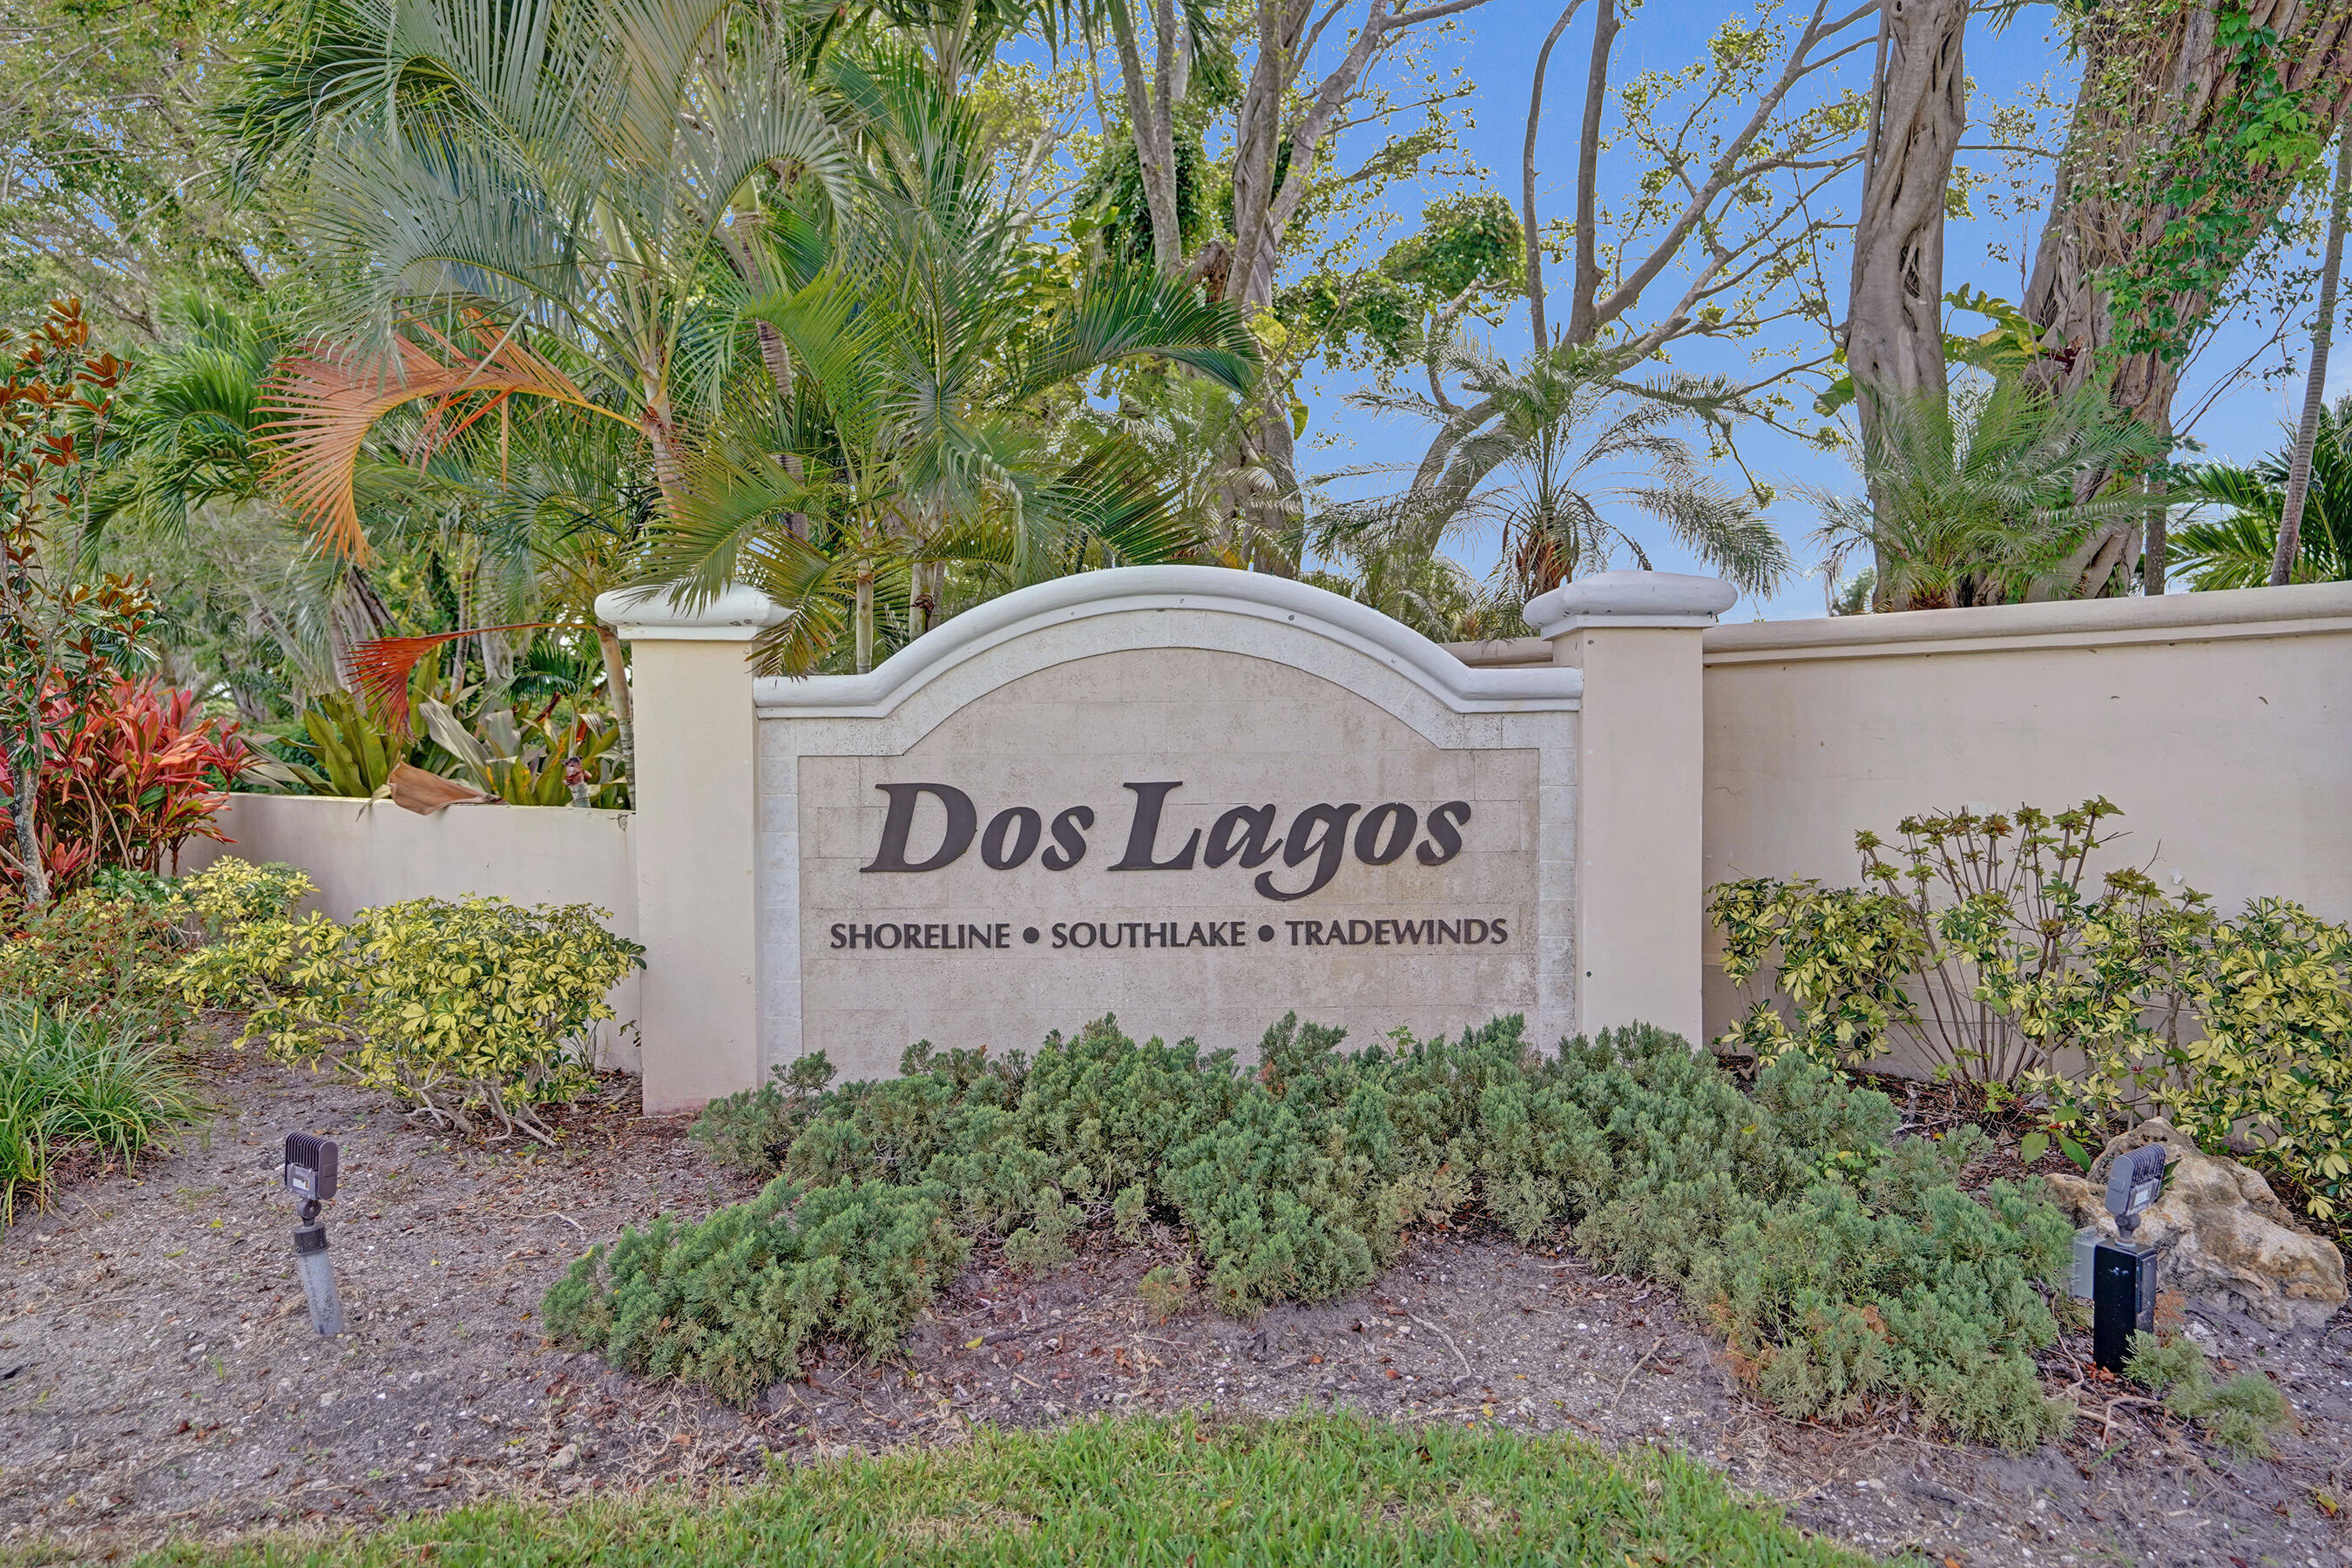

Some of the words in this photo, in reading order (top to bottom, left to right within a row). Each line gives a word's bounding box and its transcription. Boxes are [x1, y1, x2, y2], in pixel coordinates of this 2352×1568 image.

[859, 781, 1096, 874] Dos
[1107, 781, 1472, 903] Lagos
[830, 922, 1011, 950] SHORELINE
[1051, 920, 1247, 949] SOUTHLAKE
[1285, 917, 1508, 947] TRADEWINDS
